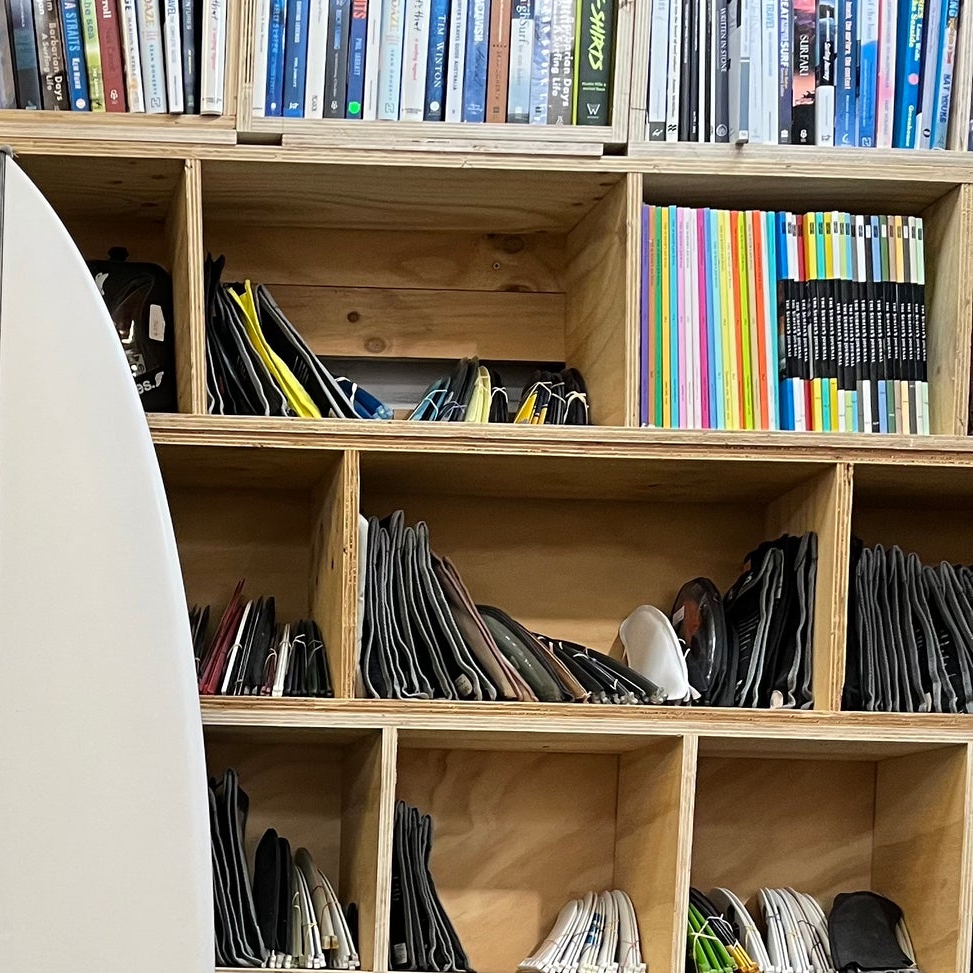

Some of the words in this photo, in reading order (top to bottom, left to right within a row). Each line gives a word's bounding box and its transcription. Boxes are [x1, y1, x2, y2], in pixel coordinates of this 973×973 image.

[65, 12, 80, 52] STRAITS
[86, 19, 94, 40] sea
[437, 15, 446, 35] TIM
[518, 19, 531, 45] Surf
[48, 22, 62, 73] Barbarian
[355, 37, 363, 50] PHIL
[720, 40, 727, 48] IN
[780, 41, 790, 68] SURF
[799, 34, 809, 76] SURFARI
[41, 42, 52, 73] Surfing
[353, 52, 362, 76] JARRATT
[433, 41, 445, 88] WINTON
[720, 48, 728, 73] STONE
[45, 74, 53, 91] Life
[53, 75, 64, 102] Days
[452, 60, 460, 91] AUSTRALIA
[552, 77, 561, 97] Life
[942, 74, 951, 90] NAT
[561, 78, 573, 107] Days
